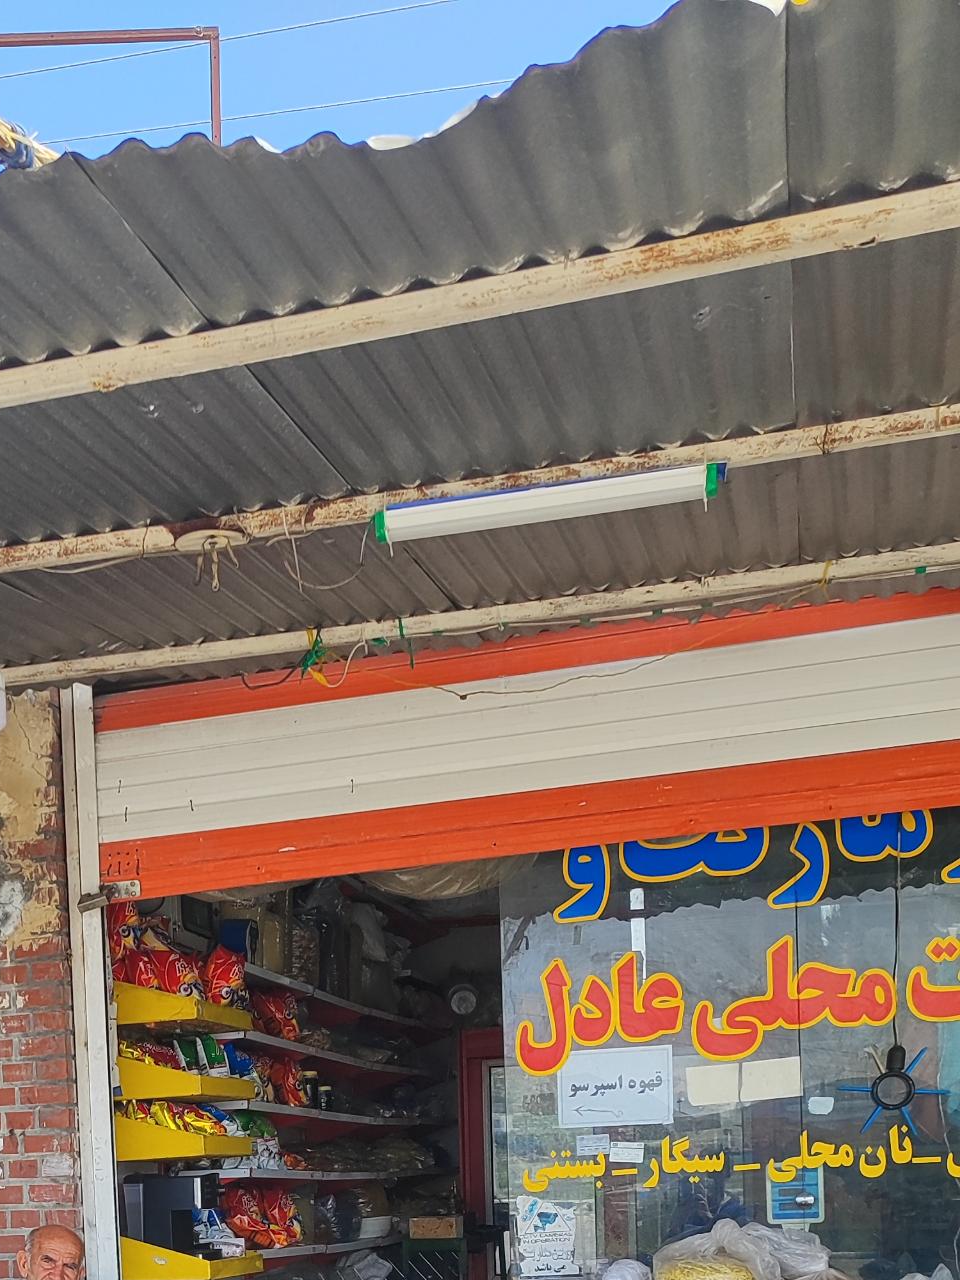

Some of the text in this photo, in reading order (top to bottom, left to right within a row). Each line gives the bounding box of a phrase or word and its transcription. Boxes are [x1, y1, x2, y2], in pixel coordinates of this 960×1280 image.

[516, 951, 684, 1075] عادل
[692, 935, 898, 1061] محلی
[569, 1071, 663, 1097] قهوه اسپرسو
[522, 1150, 606, 1193] بستنی
[643, 1134, 725, 1188] سیگار
[767, 1130, 854, 1184] محلی
[859, 1124, 913, 1178] نان
[534, 1262, 567, 1273] می باشد
